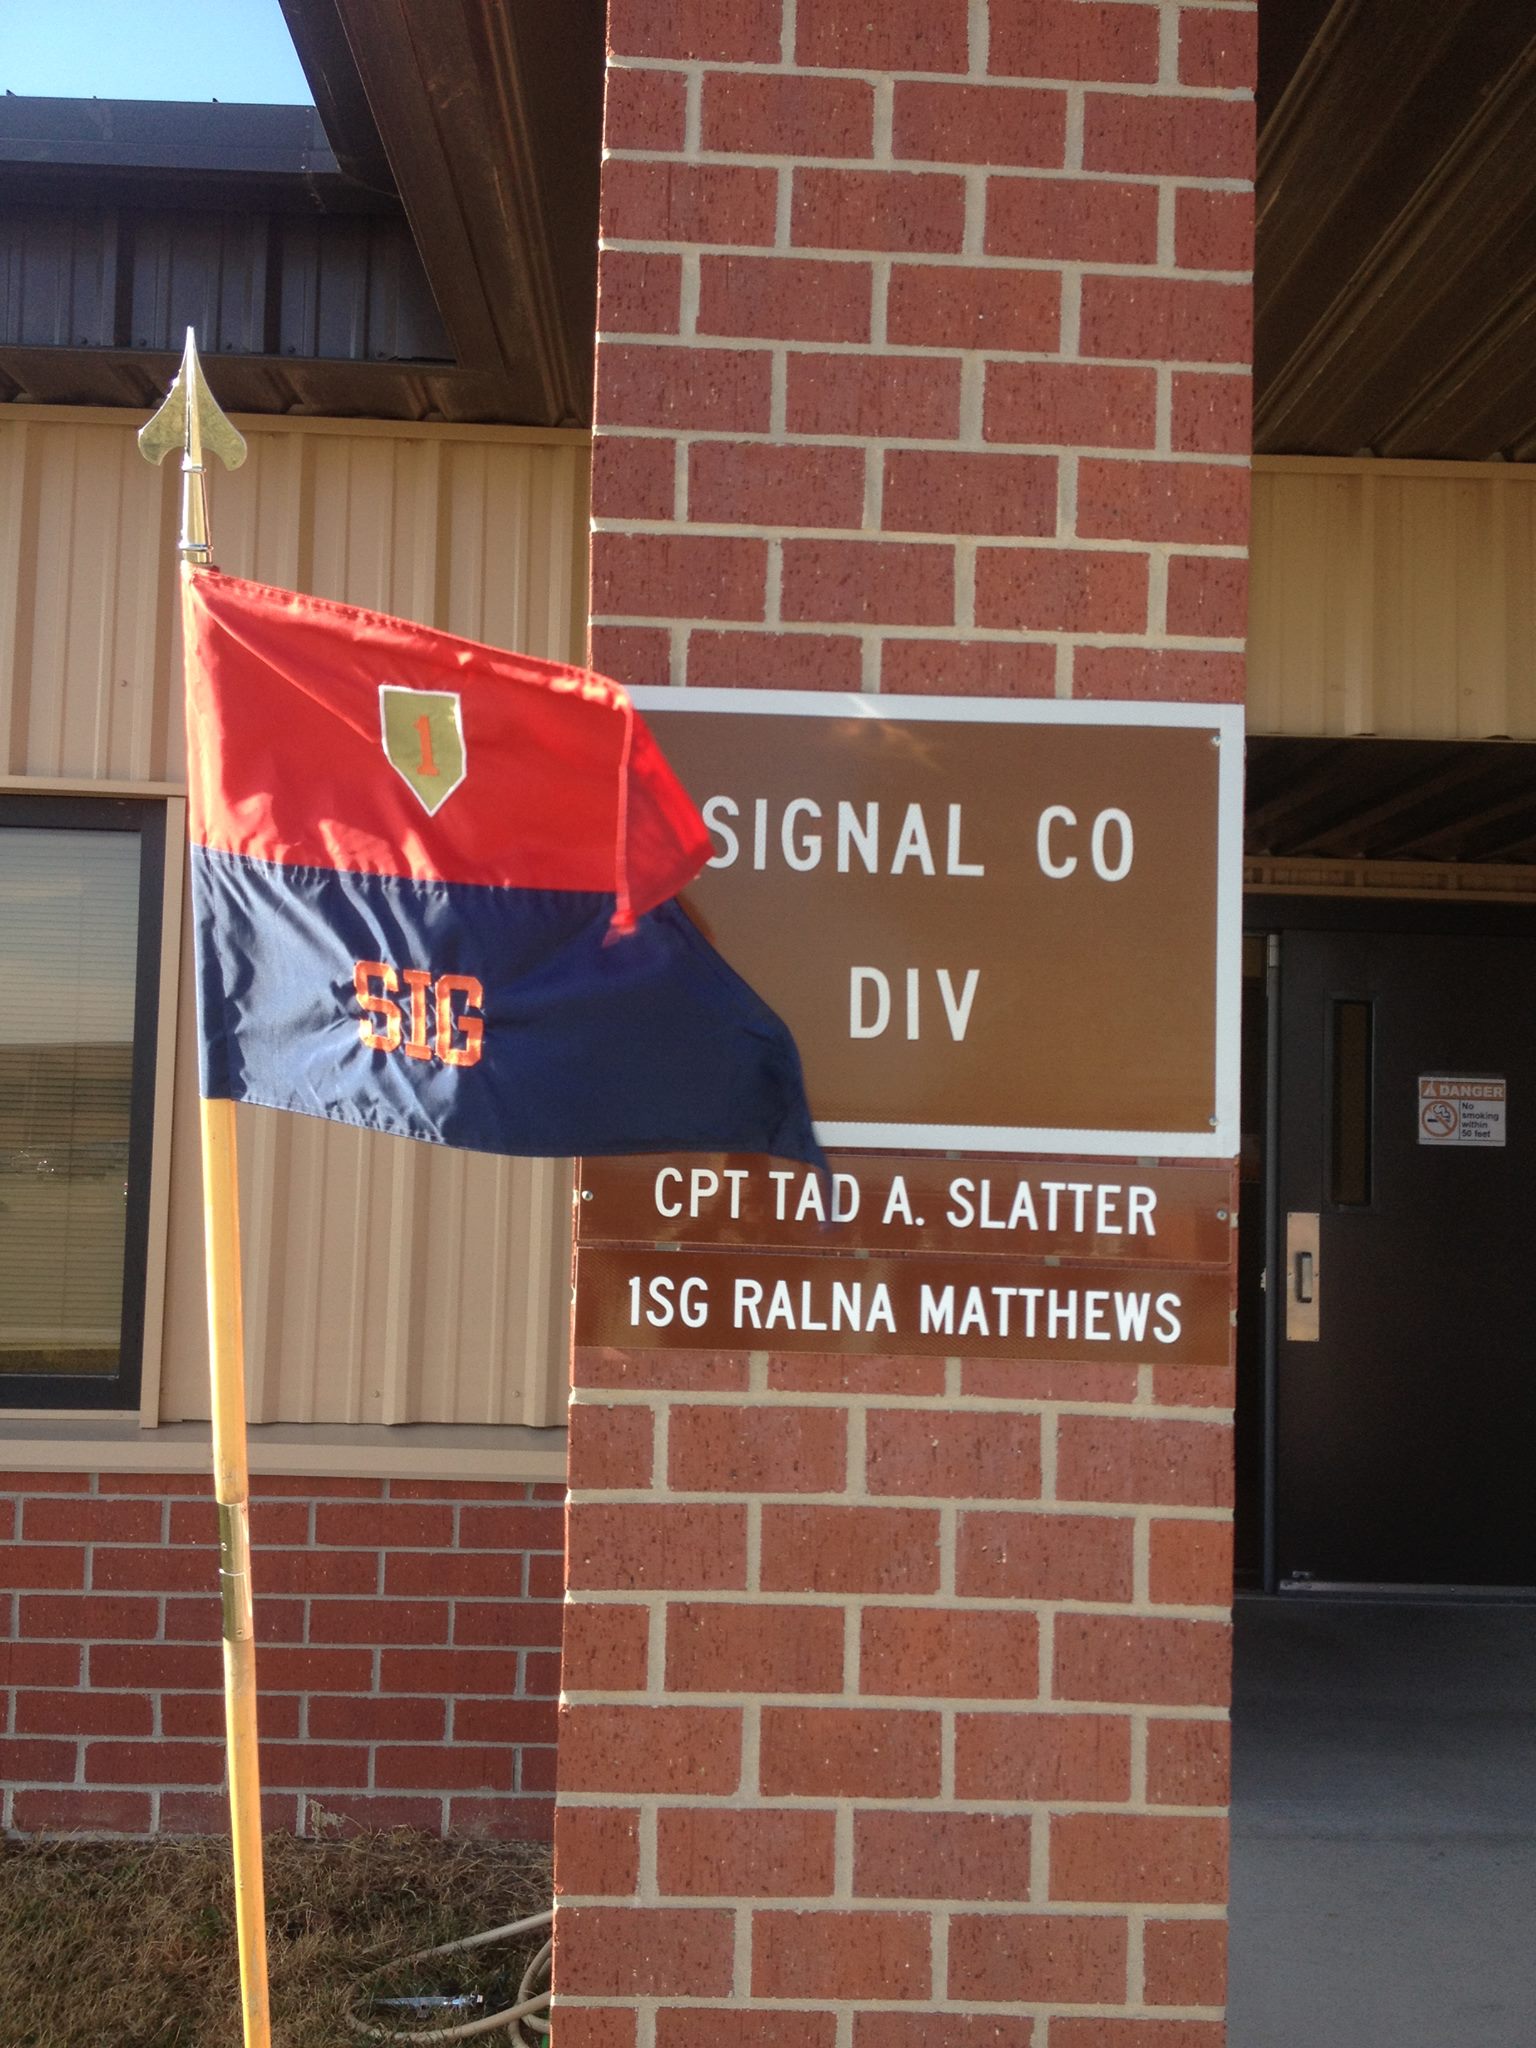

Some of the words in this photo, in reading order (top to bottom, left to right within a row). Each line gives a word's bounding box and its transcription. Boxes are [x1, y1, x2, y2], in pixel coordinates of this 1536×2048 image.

[413, 715, 440, 776] 1
[702, 796, 985, 877] SIGNAL
[1036, 806, 1134, 882] CO
[353, 960, 483, 1067] SIG
[848, 966, 980, 1042] DIV
[1440, 1085, 1504, 1097] DANGER
[1462, 1112, 1499, 1121] smoking
[1462, 1121, 1488, 1129] within
[1475, 1130, 1491, 1138] feet
[654, 1167, 749, 1218] CPT
[769, 1170, 861, 1223] TAD
[882, 1177, 925, 1227] A.
[946, 1178, 1157, 1235] SLATTER
[628, 1276, 709, 1328] 1SG
[733, 1279, 897, 1333] RALNA
[920, 1285, 1182, 1344] MATTHEWS
